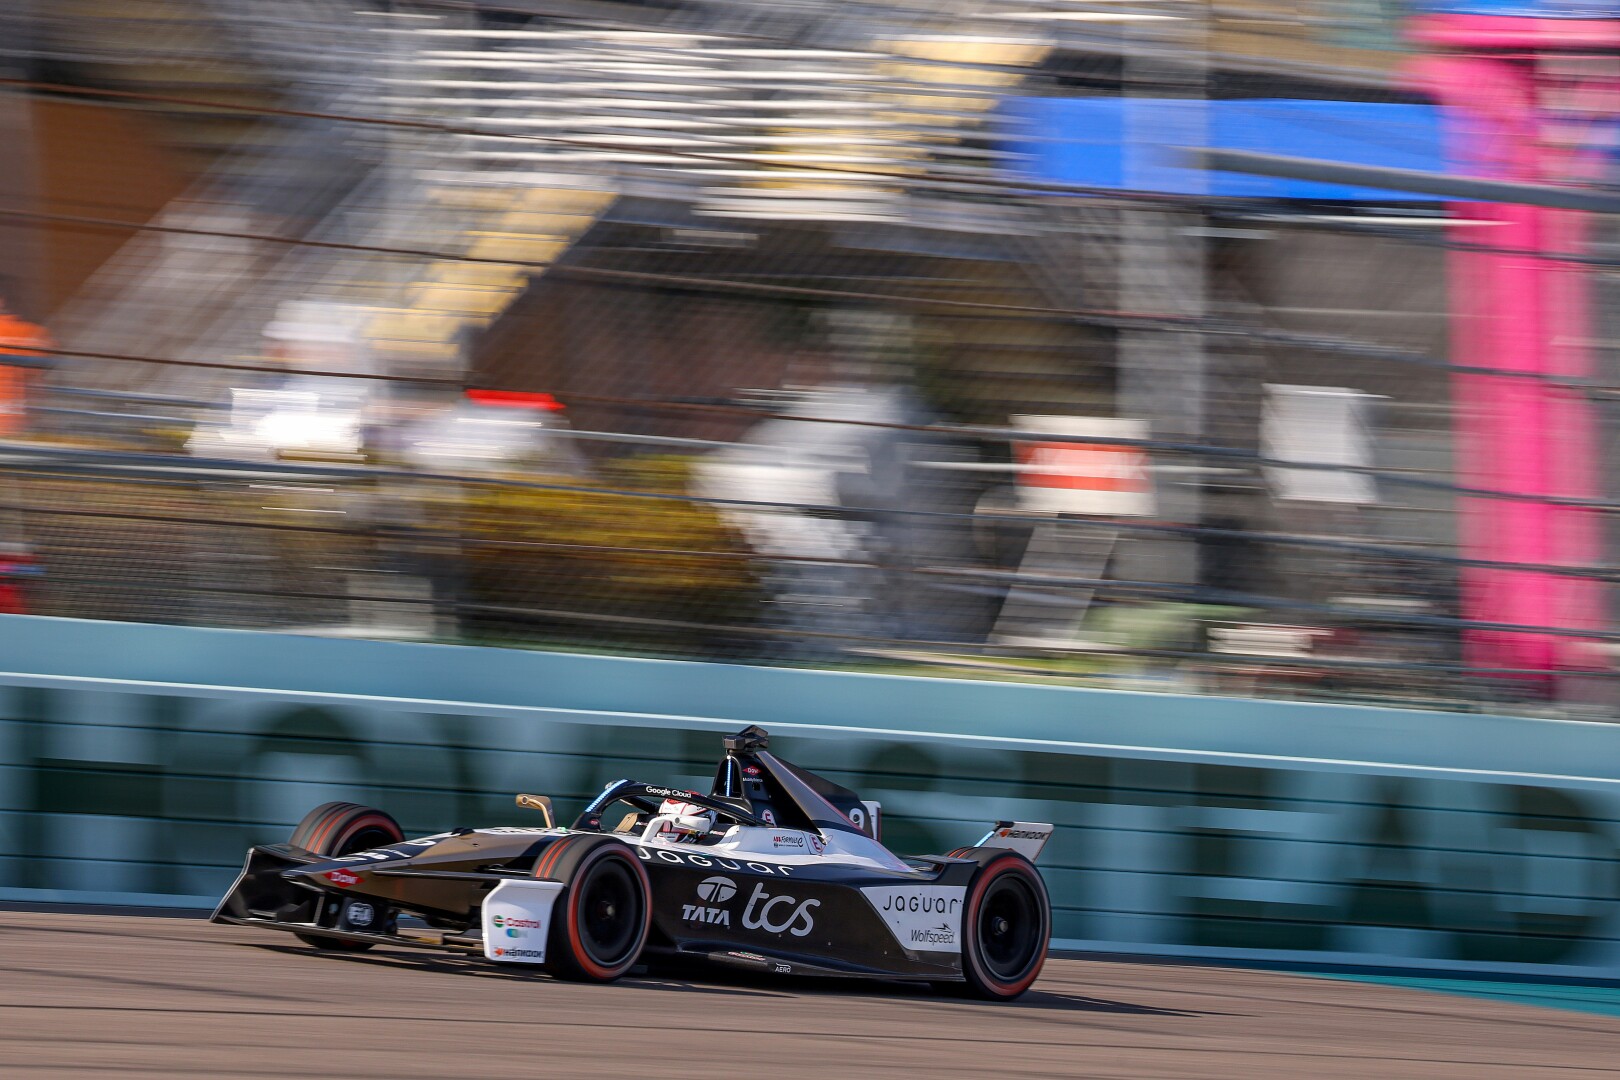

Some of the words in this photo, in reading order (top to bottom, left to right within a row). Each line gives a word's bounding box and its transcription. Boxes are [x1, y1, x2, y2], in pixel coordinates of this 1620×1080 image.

[646, 785, 671, 797] Google
[672, 788, 692, 799] Cloud
[682, 904, 730, 926] TATA
[742, 882, 821, 937] tcs
[505, 917, 541, 929] Castrol
[911, 929, 956, 946] Wolfspeed
